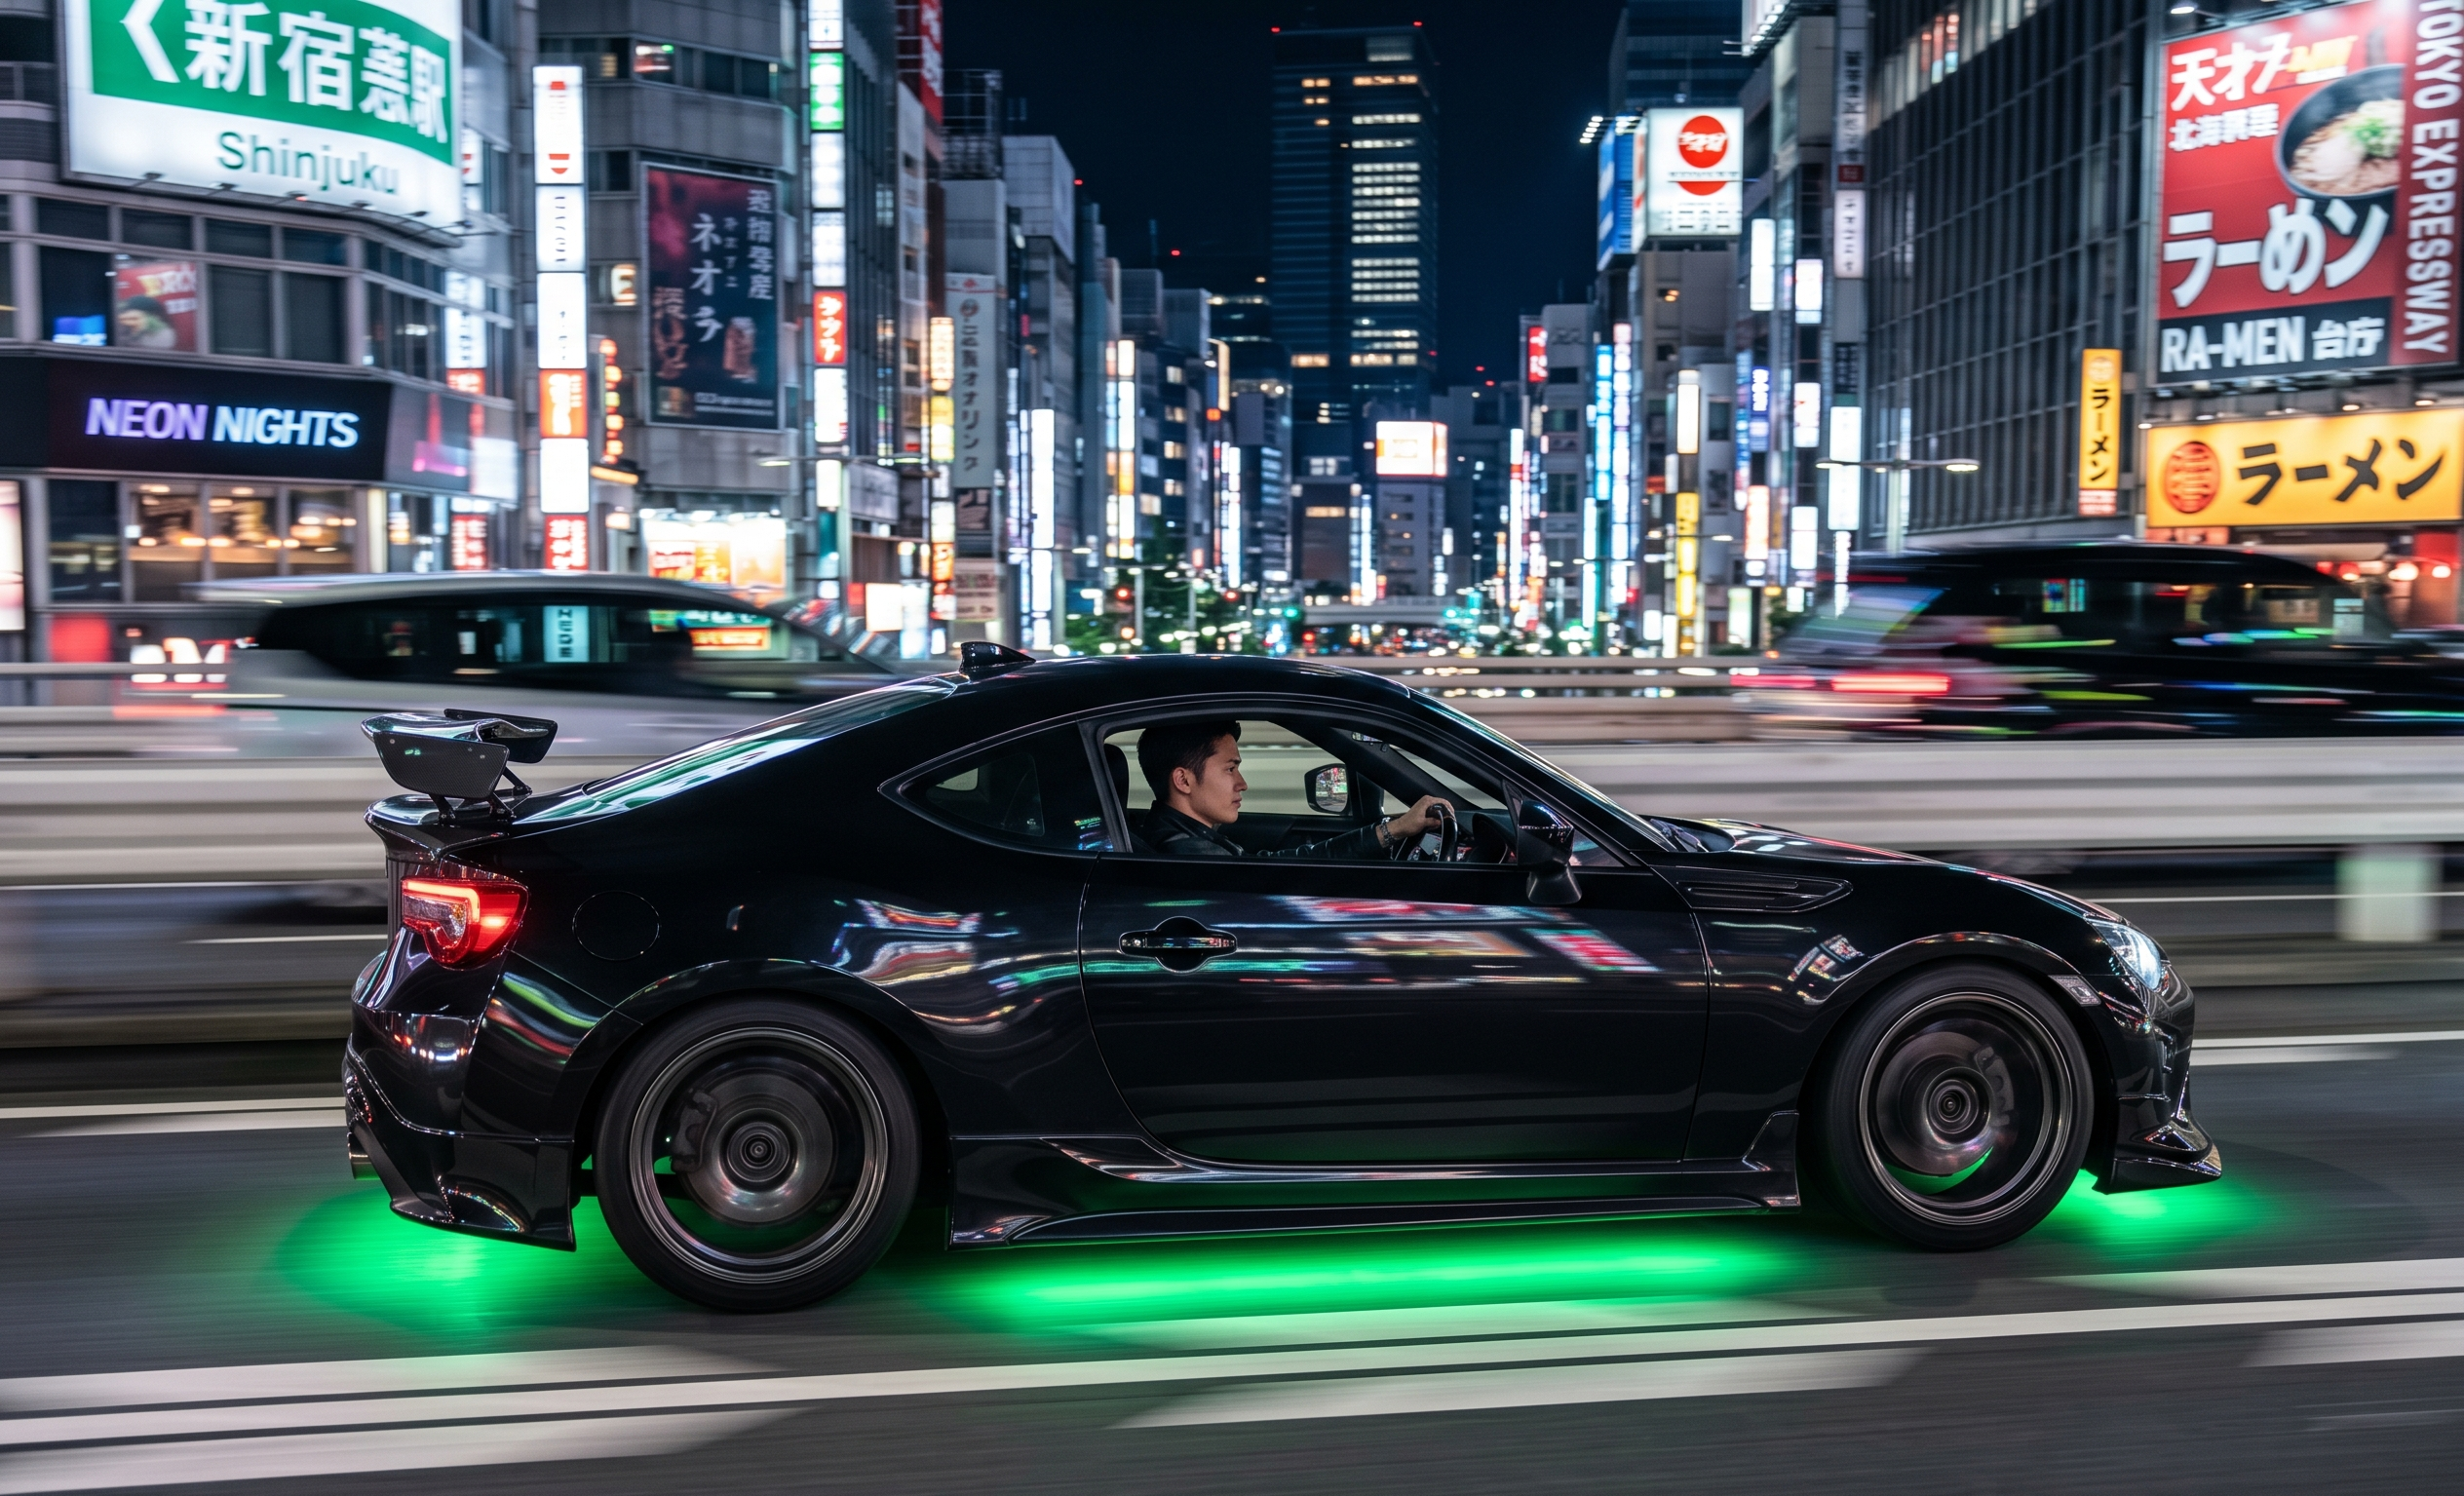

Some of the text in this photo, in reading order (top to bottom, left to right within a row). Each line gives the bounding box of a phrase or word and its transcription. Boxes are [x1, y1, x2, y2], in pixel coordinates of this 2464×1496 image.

[217, 131, 399, 195] Shinjuku
[2403, 0, 2463, 354] TOKYO EXPRESSWAY
[2163, 197, 2390, 310] ラーめン
[2160, 316, 2305, 373] RA-MEN
[85, 398, 360, 448] NEON NIGHTS
[2089, 388, 2111, 482] ラーメン
[2238, 438, 2445, 506] ラーメン
